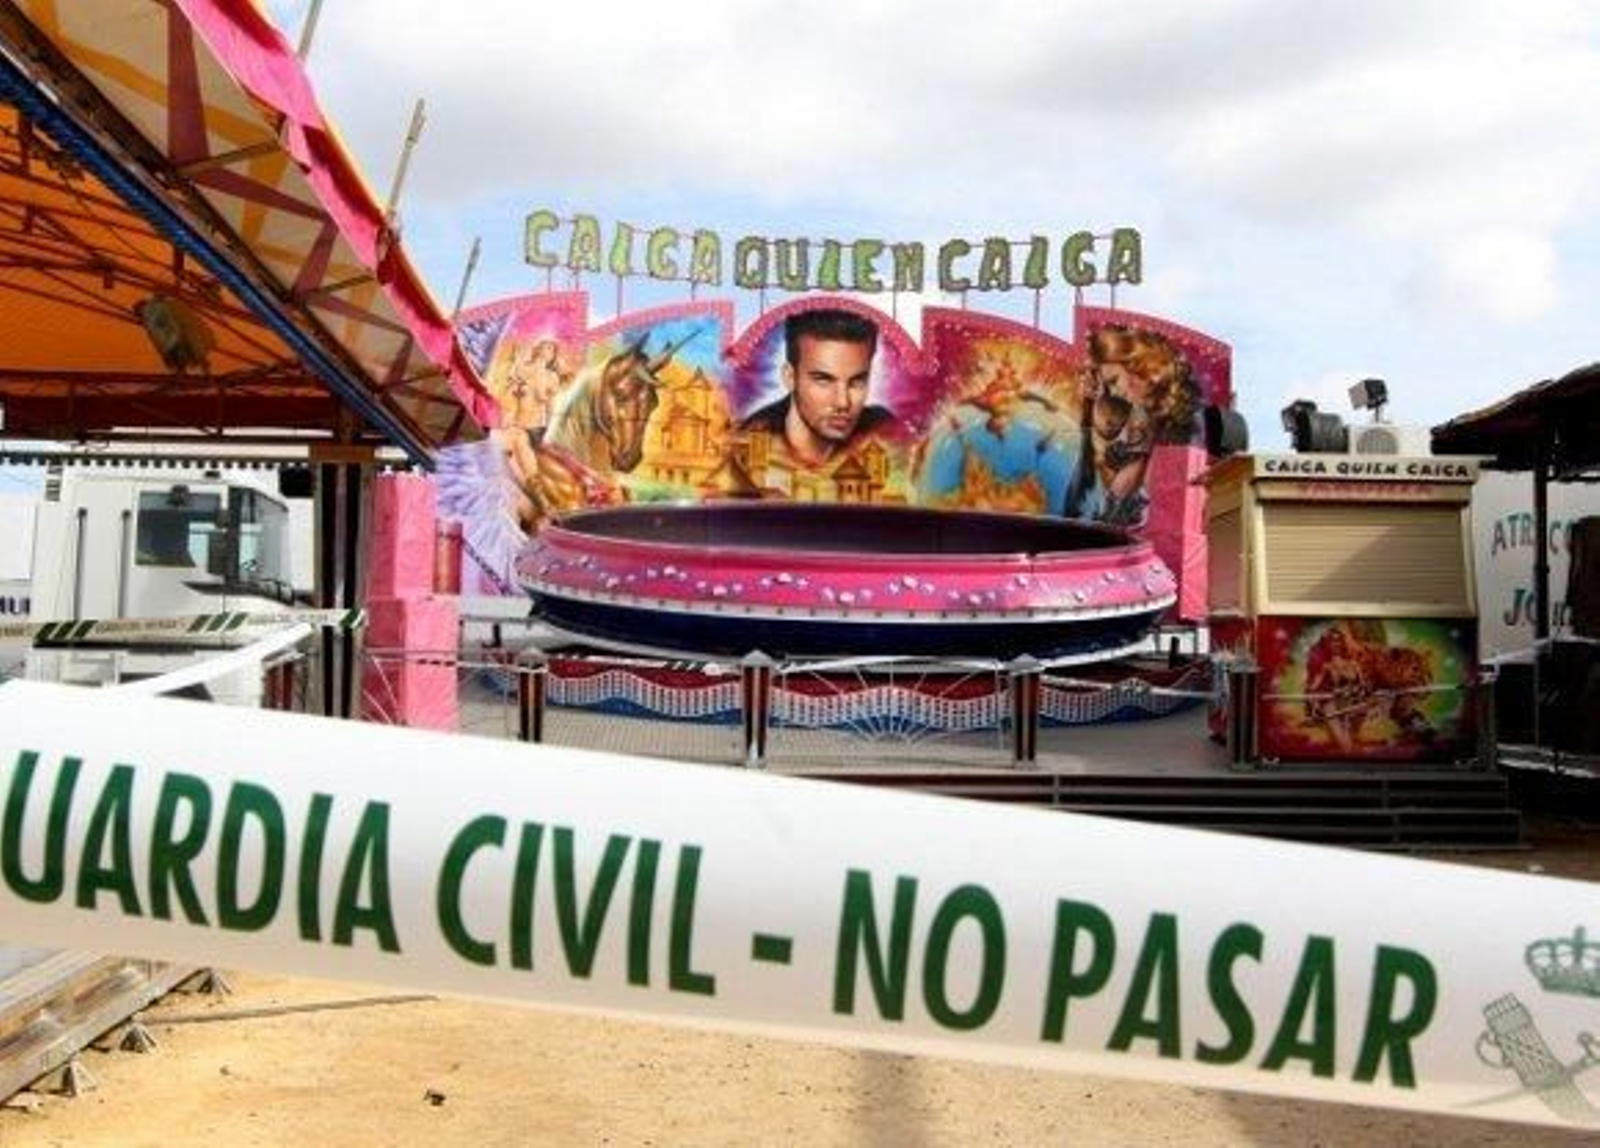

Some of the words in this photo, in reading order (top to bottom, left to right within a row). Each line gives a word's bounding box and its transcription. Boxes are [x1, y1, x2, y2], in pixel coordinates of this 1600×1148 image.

[525, 210, 721, 286] CAIGA
[734, 236, 925, 293] QUIEN
[938, 228, 1142, 291] CAIGA
[1336, 461, 1398, 475] QUIEN
[435, 813, 716, 996] CIVIL
[832, 868, 1007, 1032] NO
[1040, 897, 1438, 1090] PASAR
